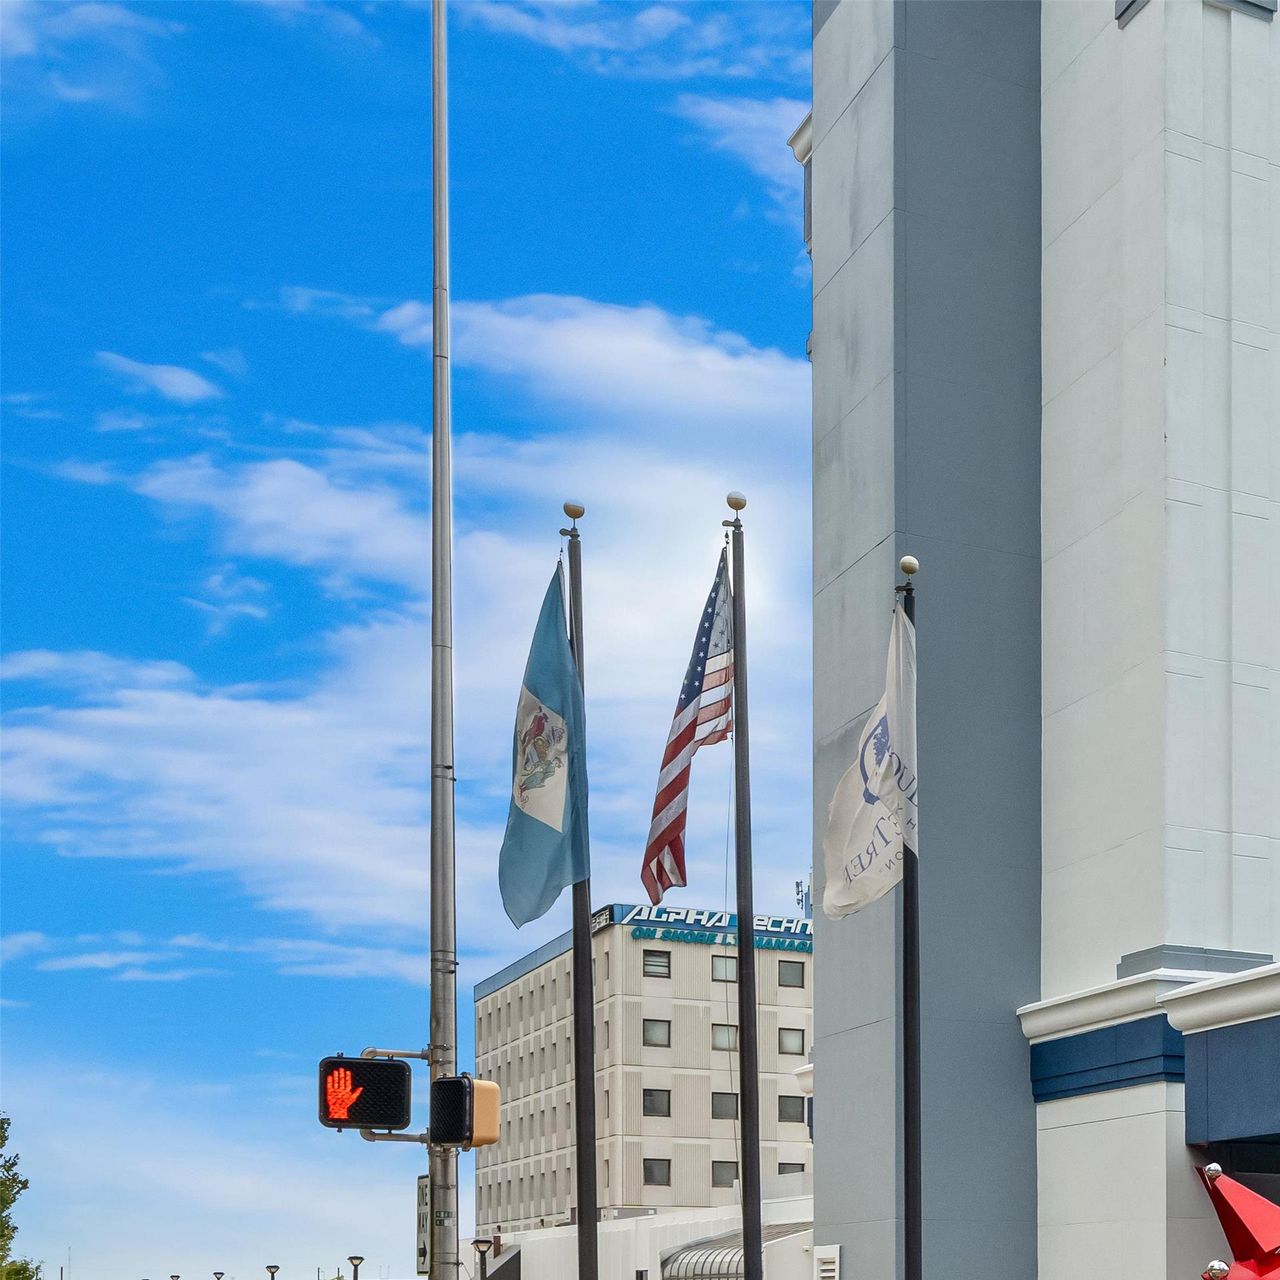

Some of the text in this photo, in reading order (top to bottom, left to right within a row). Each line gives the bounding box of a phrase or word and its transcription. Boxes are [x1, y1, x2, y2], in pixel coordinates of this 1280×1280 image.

[621, 905, 730, 927] ALPHA
[631, 926, 657, 939] ON
[661, 928, 718, 945] SHORE
